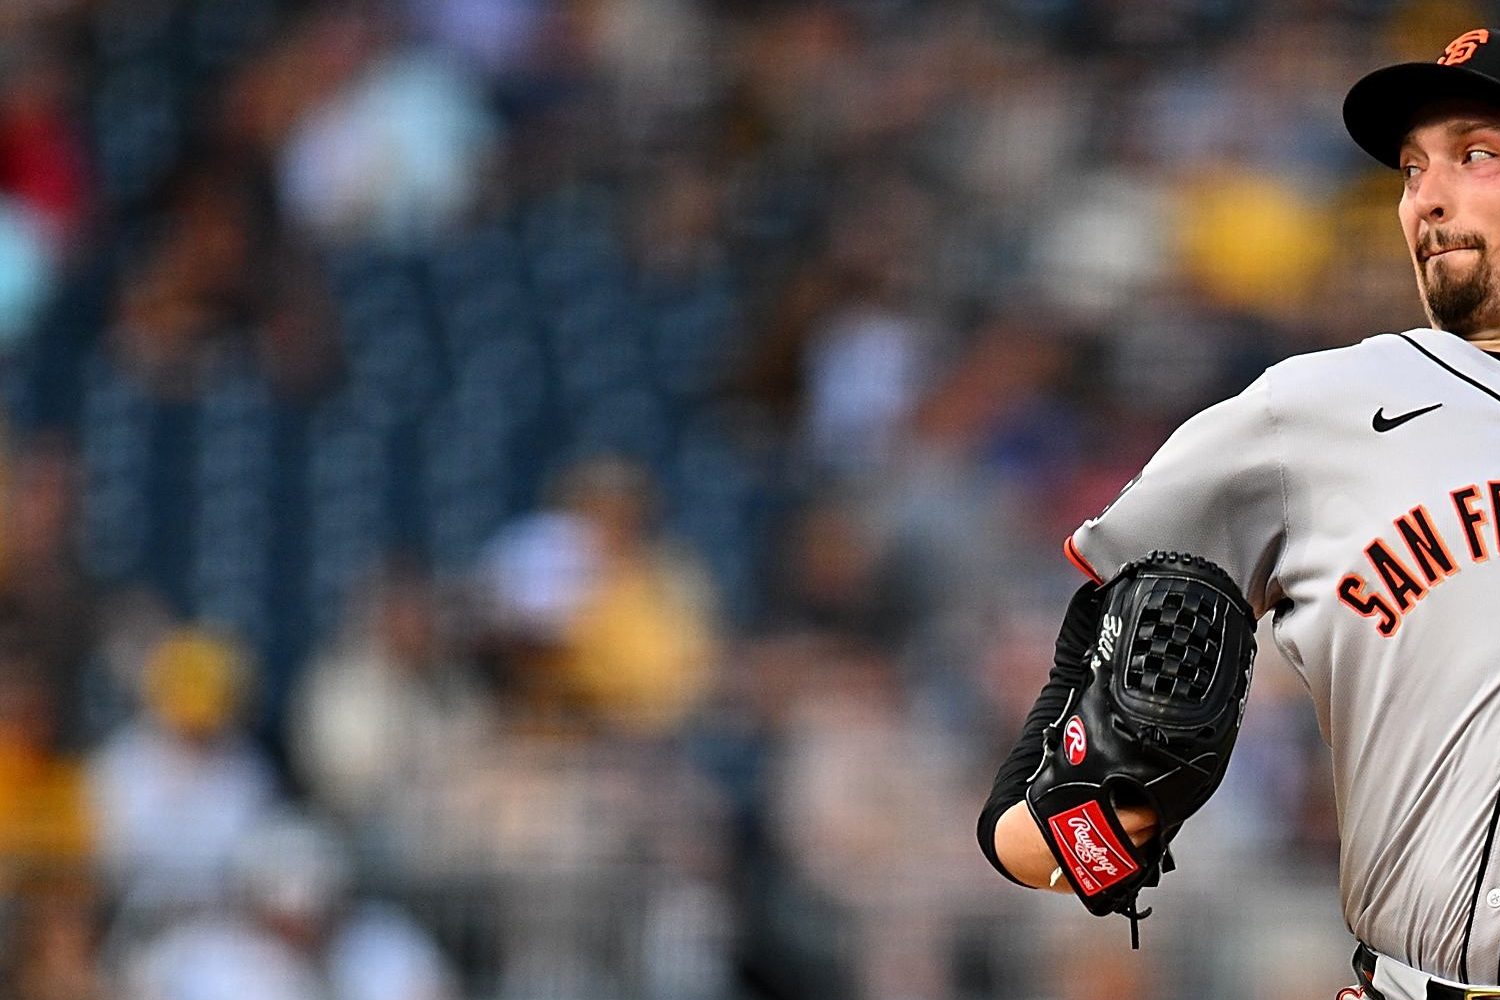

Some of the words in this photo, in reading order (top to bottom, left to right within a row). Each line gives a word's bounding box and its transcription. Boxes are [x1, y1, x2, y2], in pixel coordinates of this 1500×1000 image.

[1336, 504, 1461, 638] SAN
[1065, 718, 1087, 762] R
[1068, 817, 1118, 875] Rawlings
